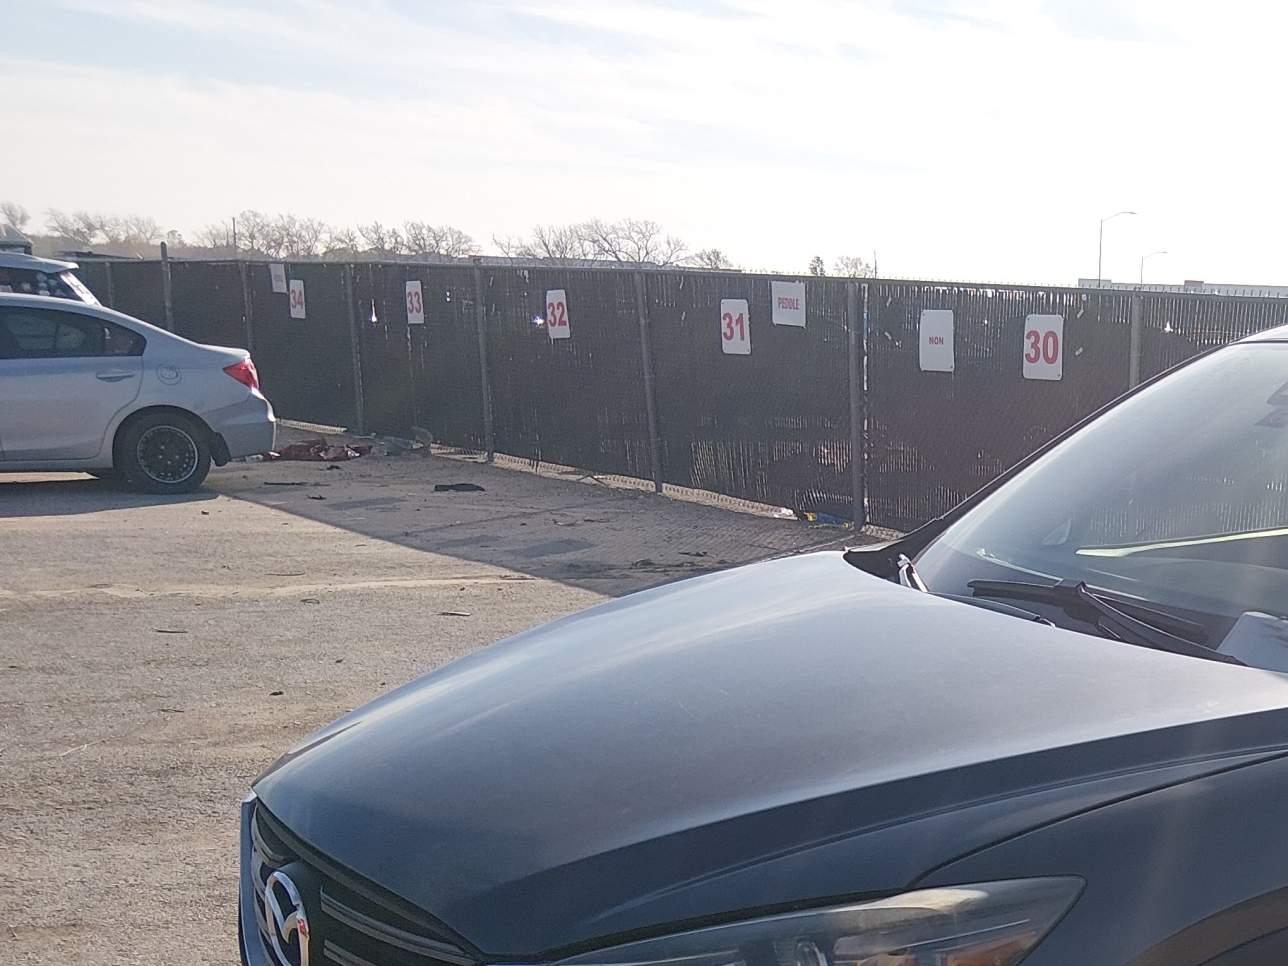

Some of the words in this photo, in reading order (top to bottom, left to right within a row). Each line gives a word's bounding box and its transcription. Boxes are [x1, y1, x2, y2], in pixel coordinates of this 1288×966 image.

[290, 289, 304, 310] 34
[407, 291, 422, 314] 33
[547, 302, 568, 327] 32
[722, 312, 745, 341] 31
[928, 336, 944, 345] NON
[1024, 330, 1059, 365] 30
